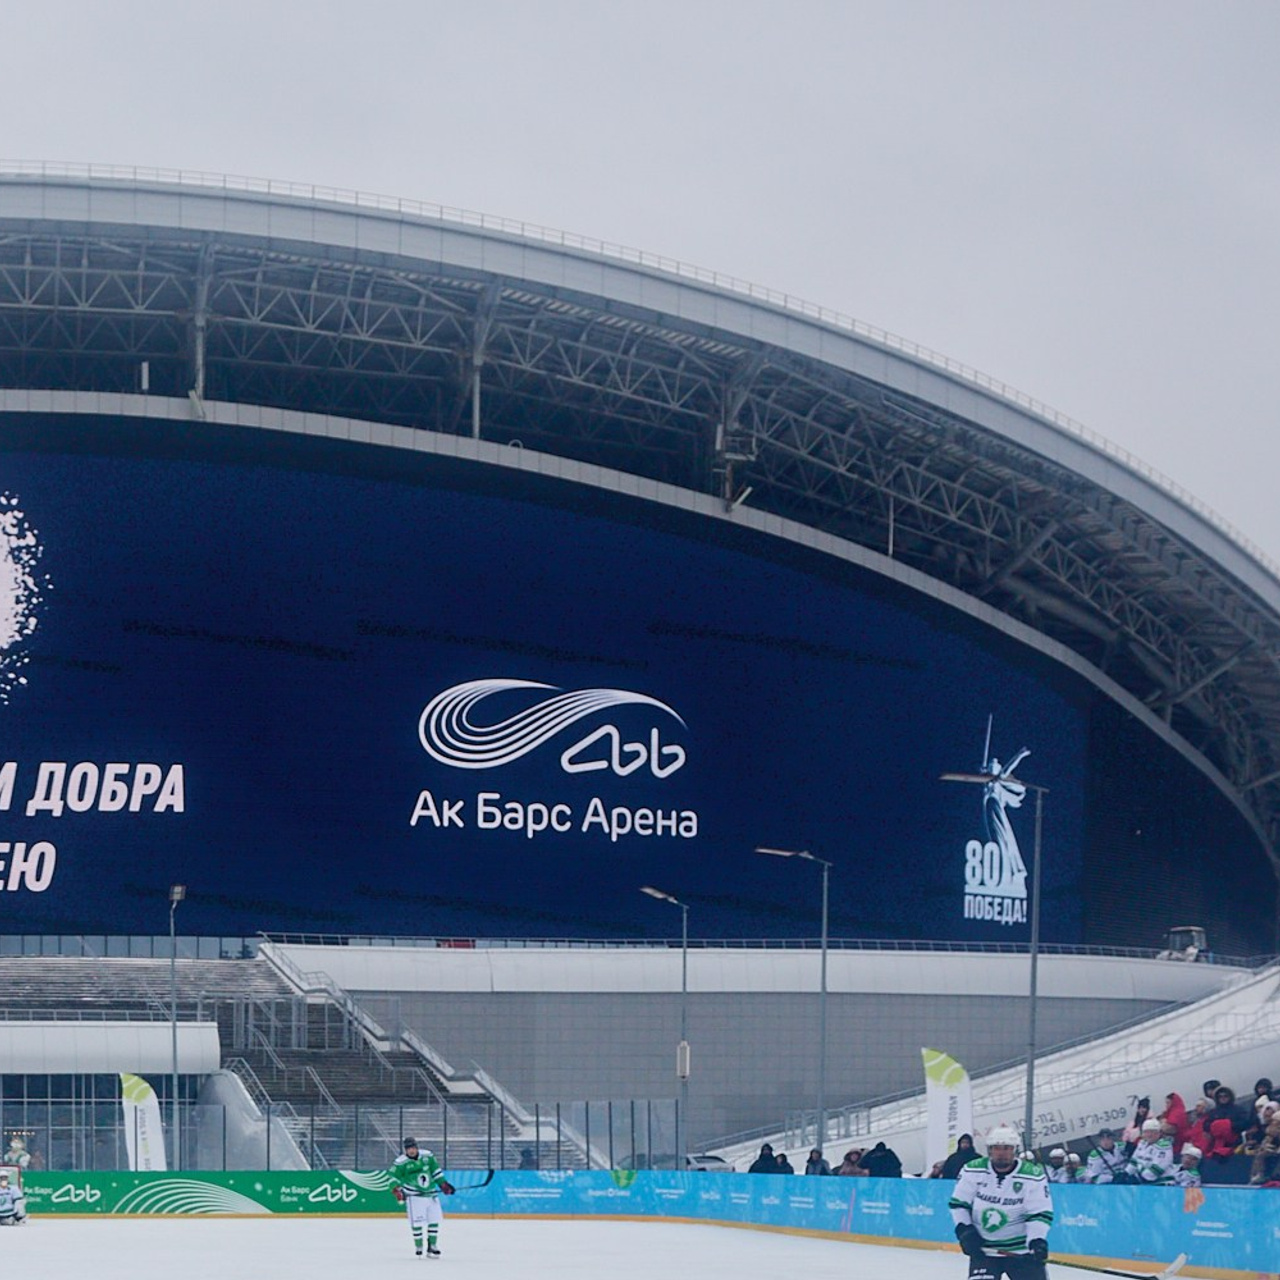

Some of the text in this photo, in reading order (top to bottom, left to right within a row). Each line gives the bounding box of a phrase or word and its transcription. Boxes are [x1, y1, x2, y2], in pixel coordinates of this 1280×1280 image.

[25, 762, 185, 817] ДОБРА
[410, 790, 698, 842] Ак Барс Арена
[964, 839, 1000, 886] 80
[963, 894, 1027, 926] ПОБЕДА!
[1013, 1111, 1056, 1130] 10-112
